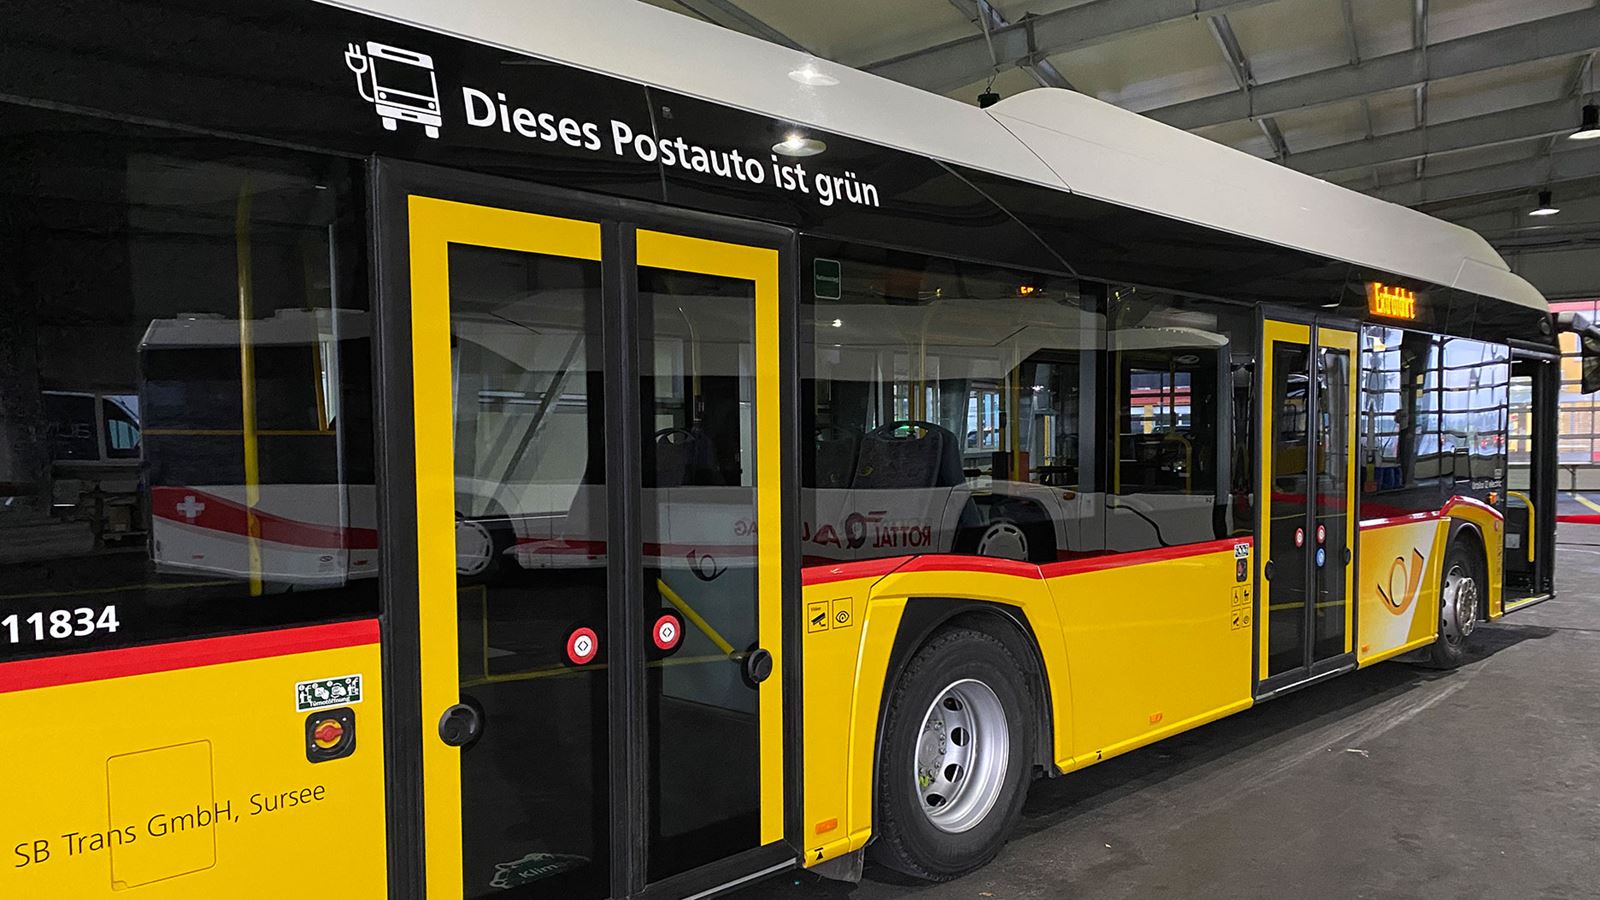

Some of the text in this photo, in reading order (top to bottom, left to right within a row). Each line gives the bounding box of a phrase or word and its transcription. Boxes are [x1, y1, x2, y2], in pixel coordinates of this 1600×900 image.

[462, 86, 880, 207] Dieses Postauto ist grün
[1, 604, 120, 644] 11834
[14, 784, 326, 868] SB Trans GmbH, Sursee
